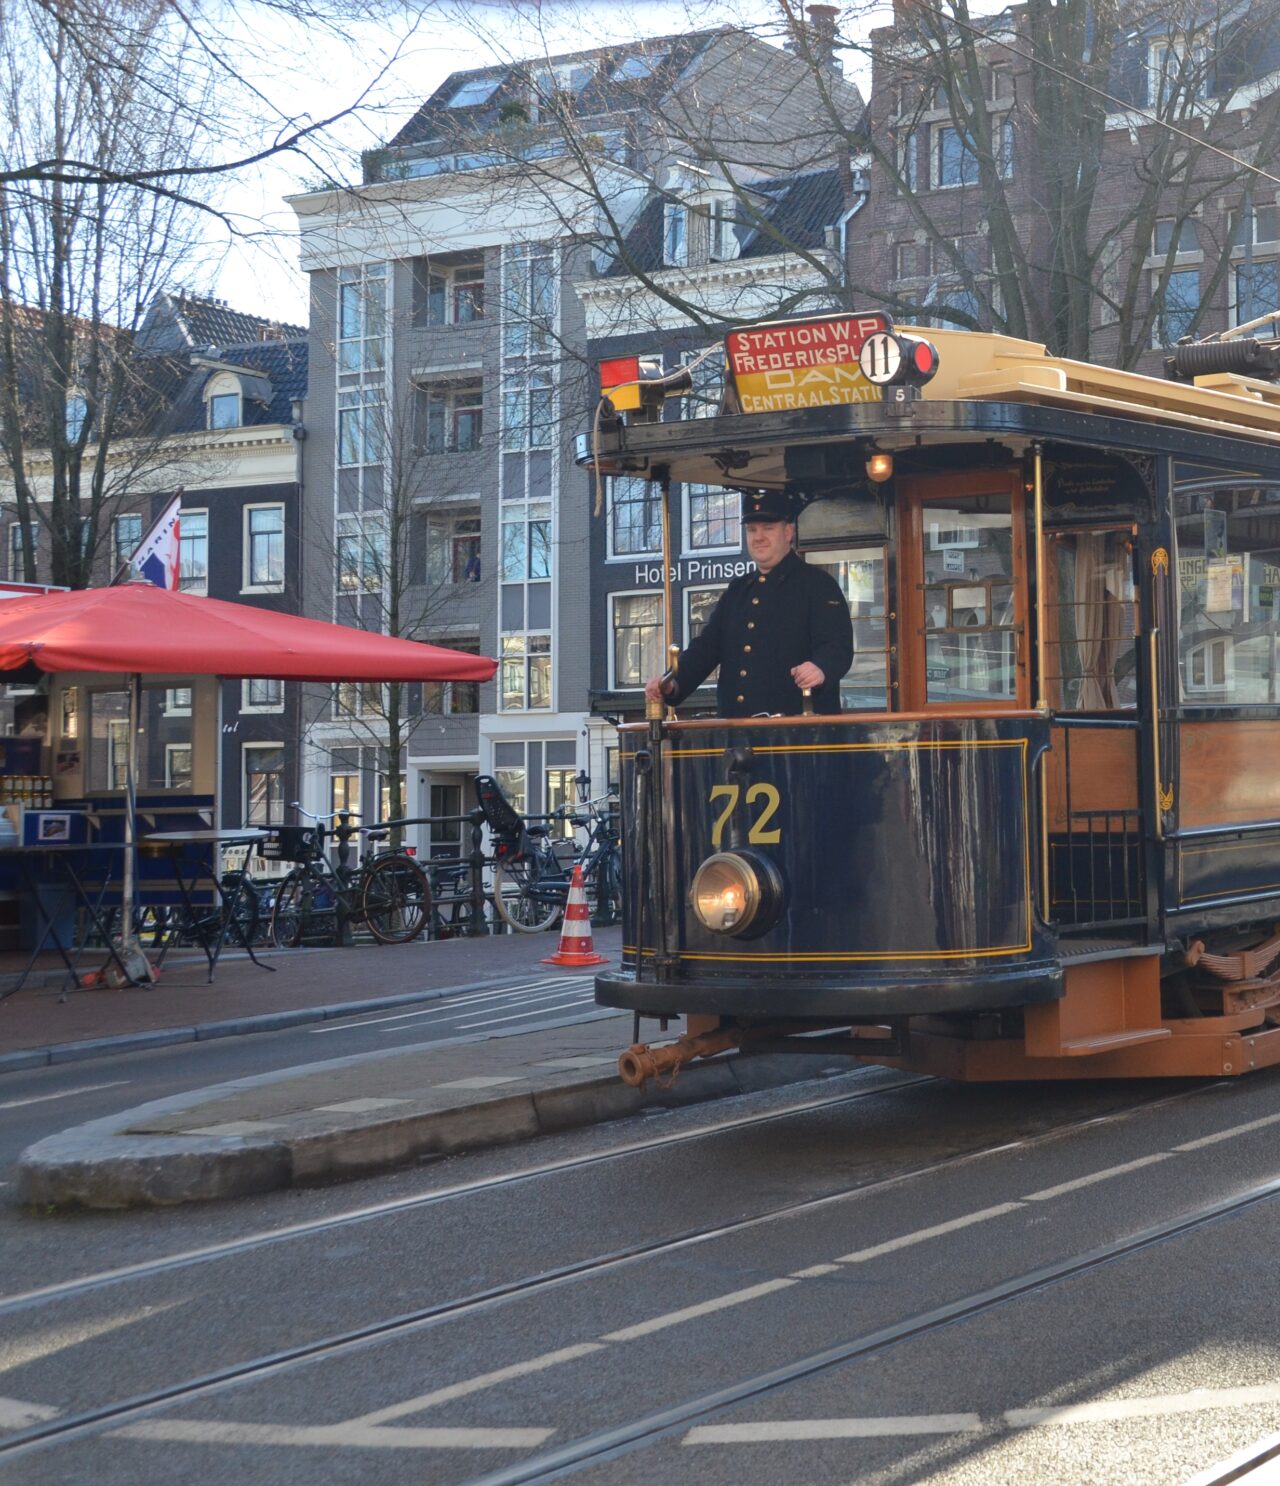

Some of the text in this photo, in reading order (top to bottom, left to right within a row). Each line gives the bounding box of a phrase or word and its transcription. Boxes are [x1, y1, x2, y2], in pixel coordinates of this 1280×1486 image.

[737, 325, 828, 351] STATION
[734, 344, 861, 373] FREDERIKSPL
[868, 336, 891, 378] 11
[765, 367, 864, 390] DAM
[895, 388, 905, 402] 5
[635, 560, 757, 585] Hotel Prinsen
[708, 782, 781, 846] 72
